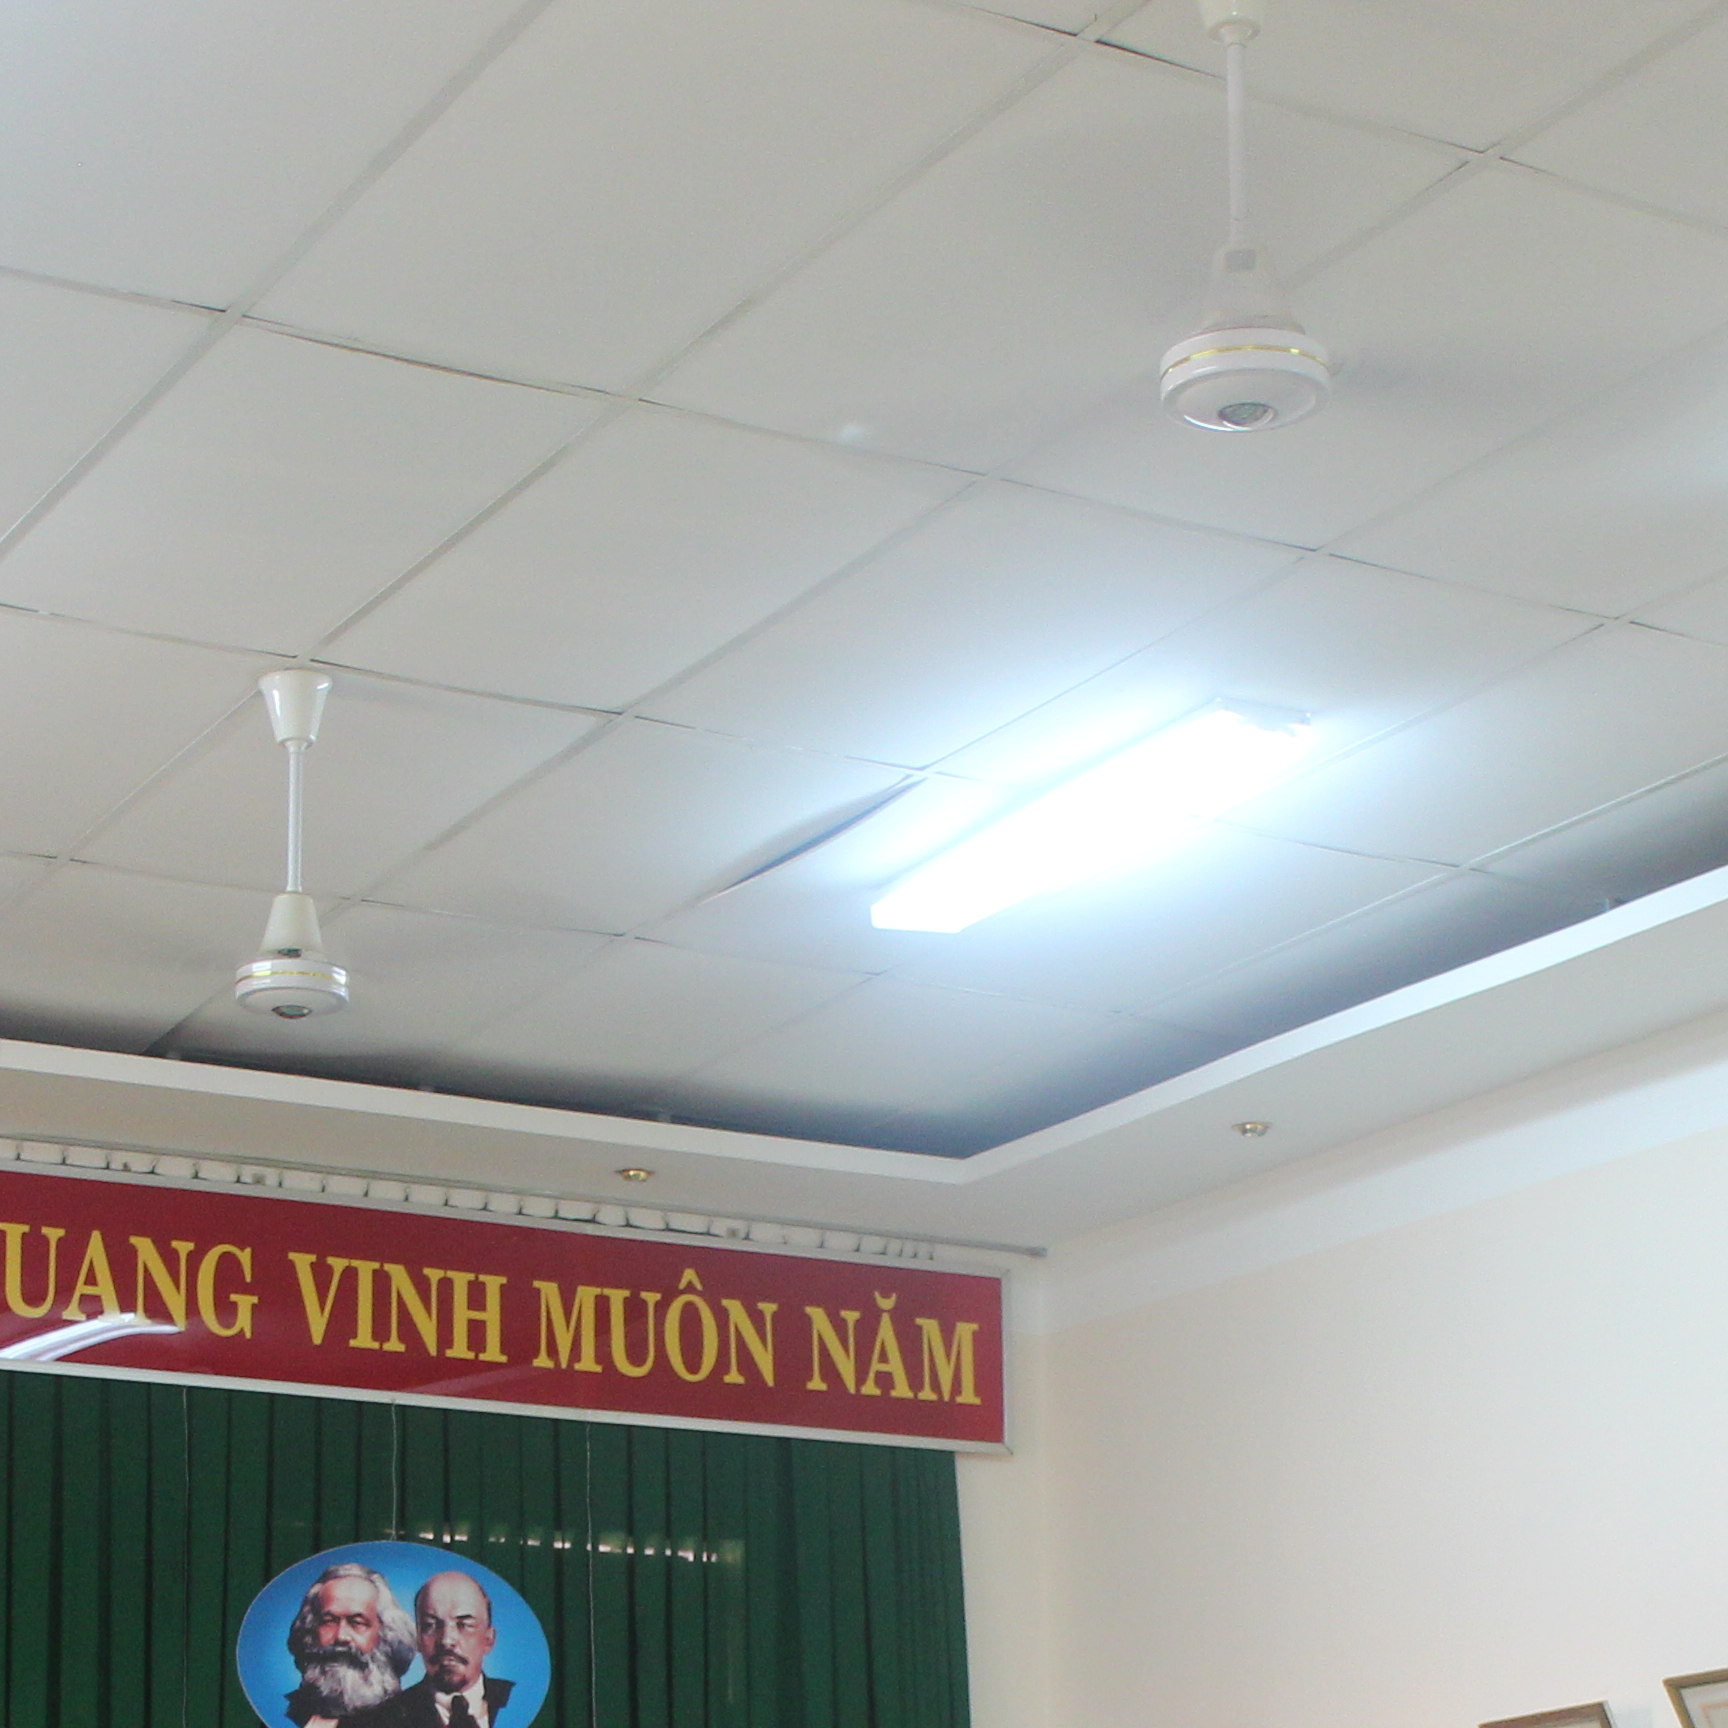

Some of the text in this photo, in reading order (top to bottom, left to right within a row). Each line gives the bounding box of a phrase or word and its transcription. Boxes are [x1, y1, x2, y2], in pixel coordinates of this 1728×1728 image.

[288, 1250, 506, 1364] VINH
[532, 1272, 777, 1388] MUÔN
[806, 1291, 982, 1405] NĂM
